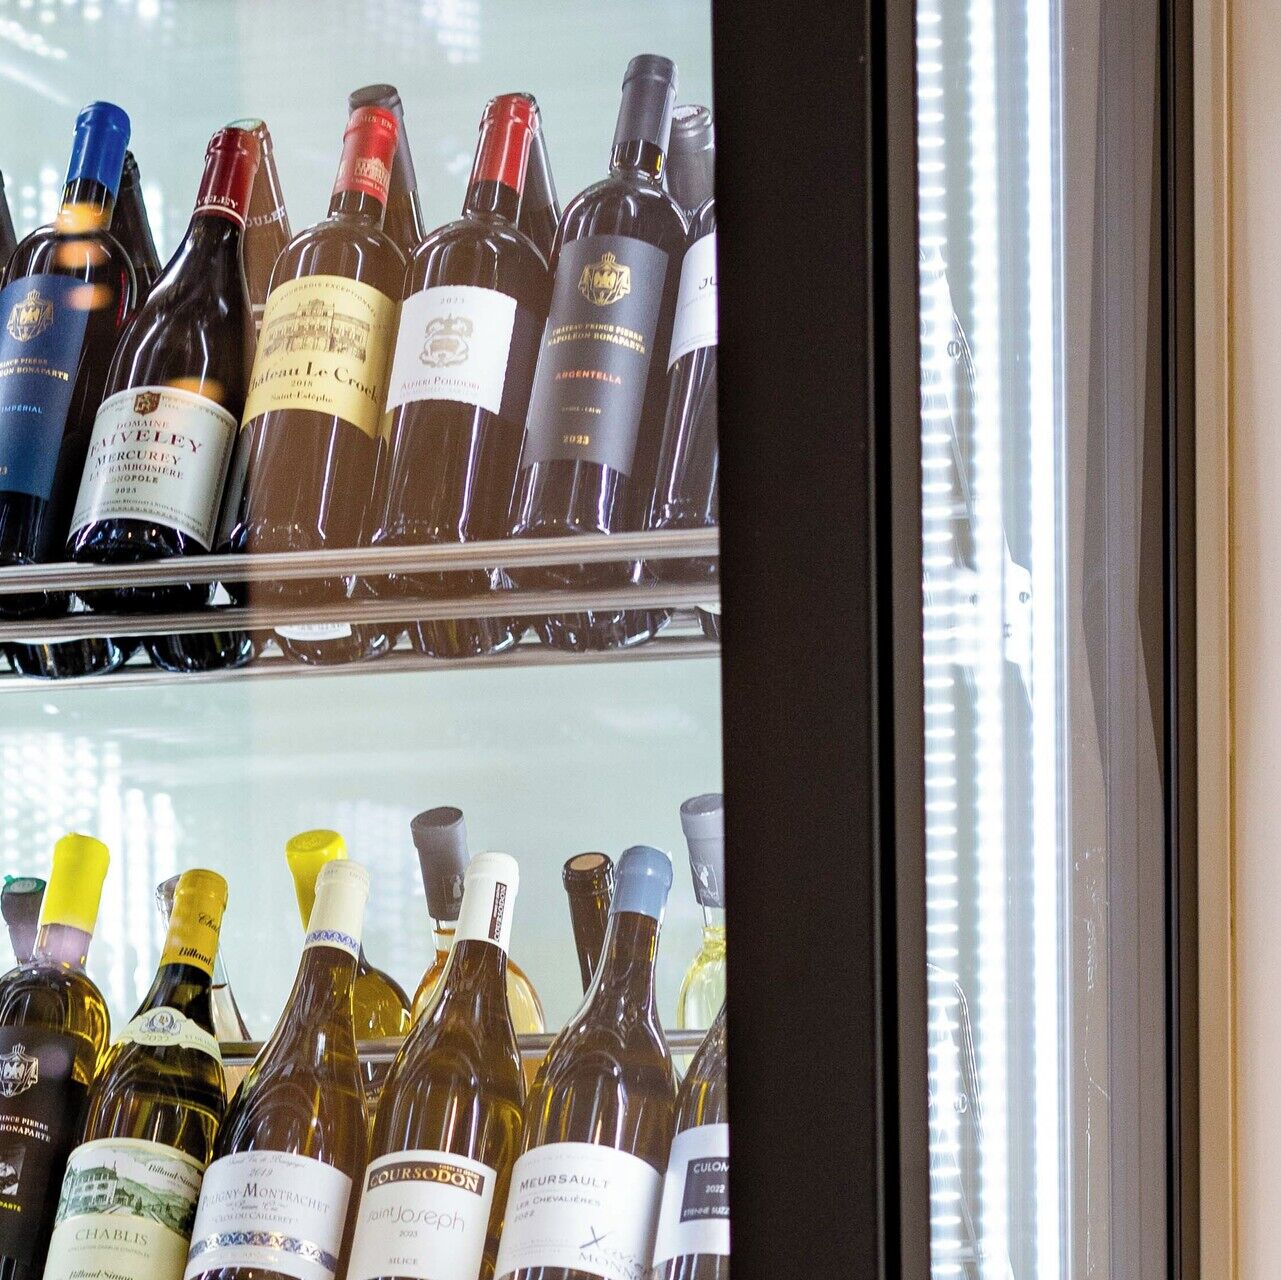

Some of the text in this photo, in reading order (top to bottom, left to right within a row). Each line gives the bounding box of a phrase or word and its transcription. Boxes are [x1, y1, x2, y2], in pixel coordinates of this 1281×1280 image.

[305, 361, 328, 377] Le
[0, 1123, 51, 1143] BONAPARTE
[21, 1117, 49, 1132] PIERRE
[370, 1168, 480, 1193] COURSODON
[520, 1174, 611, 1192] MEURSAULT
[75, 1228, 149, 1246] CHABLIS
